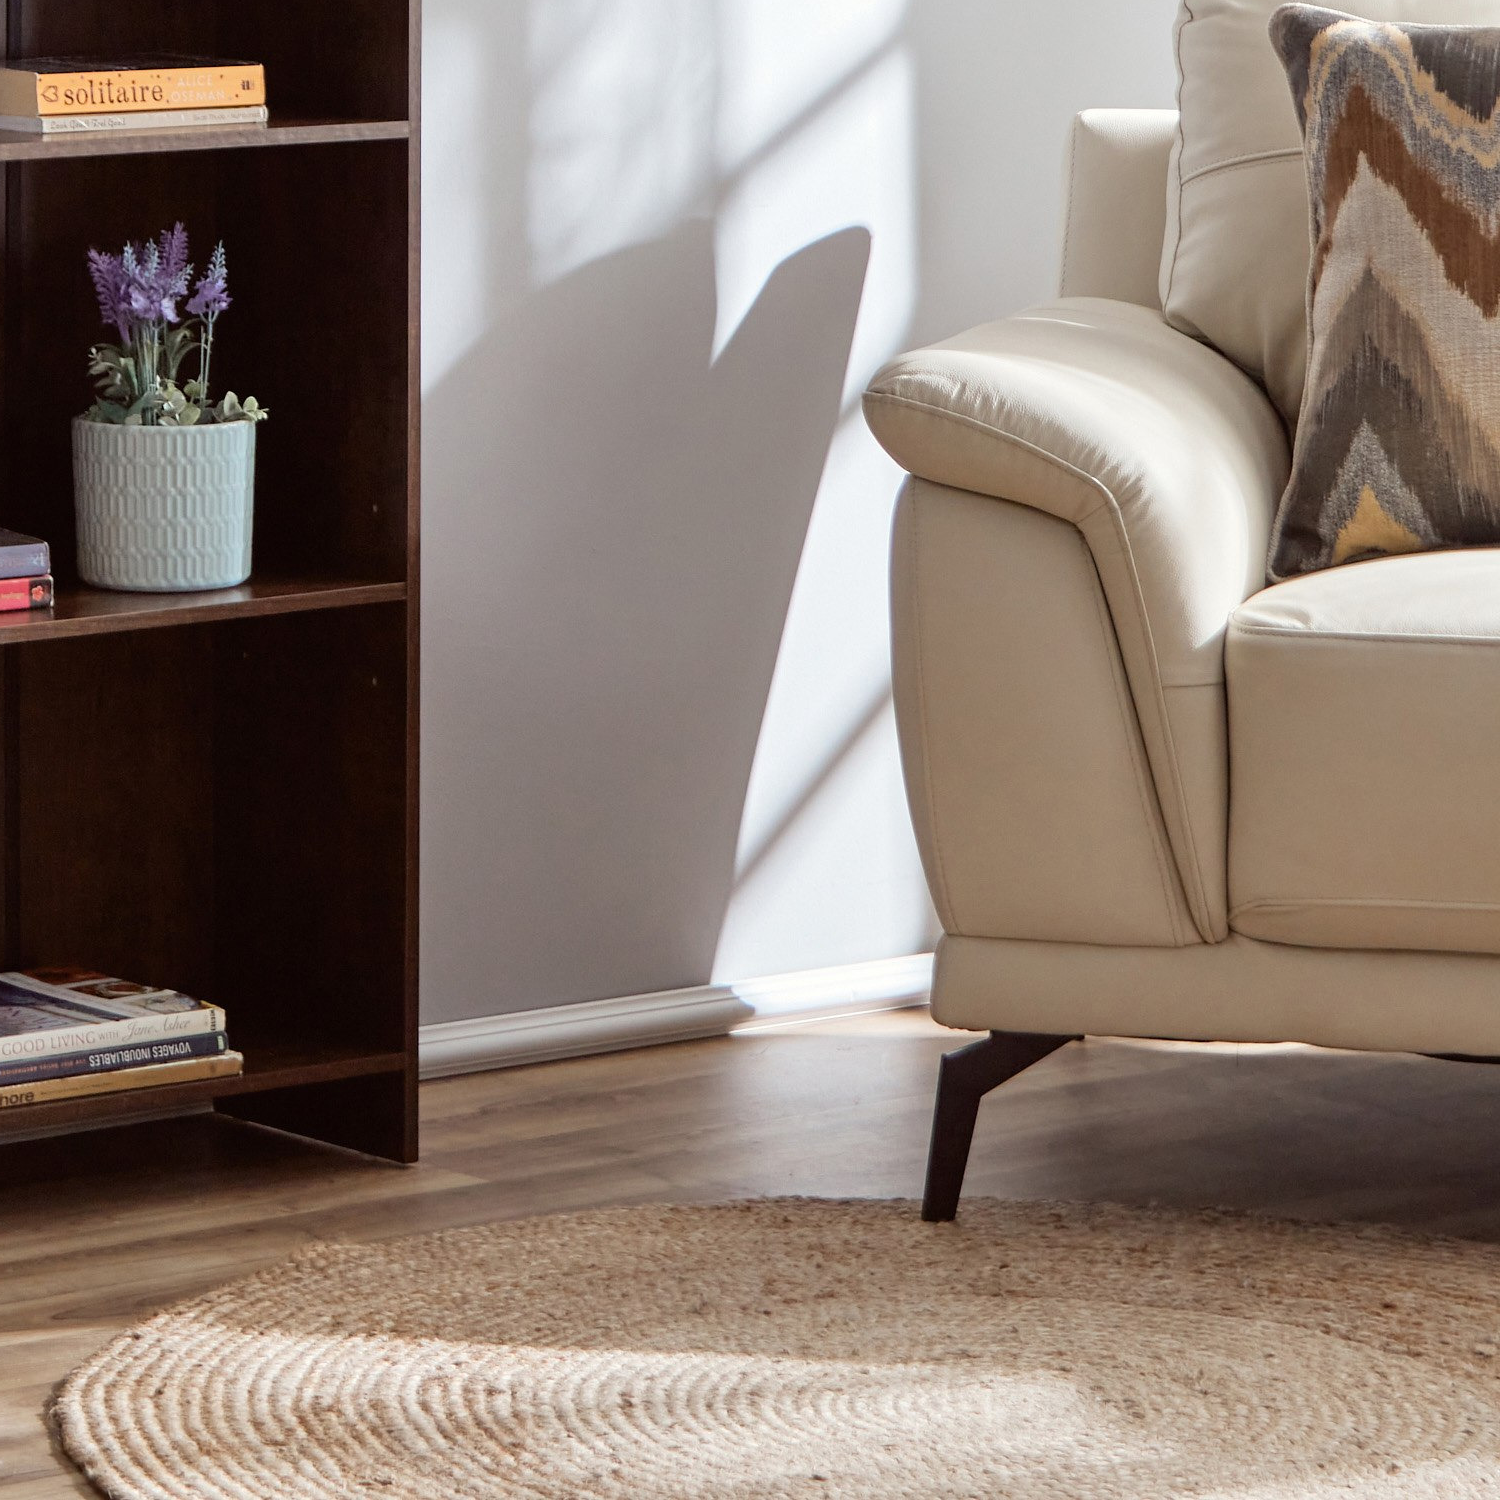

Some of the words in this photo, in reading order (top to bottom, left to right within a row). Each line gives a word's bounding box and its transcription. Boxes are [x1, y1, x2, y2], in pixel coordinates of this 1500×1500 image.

[176, 74, 214, 89] ALICE
[63, 78, 164, 107] solitaire
[170, 88, 227, 103] OSEMAN
[2, 1037, 45, 1056] GOOD
[50, 1031, 96, 1050] LIVING
[98, 1029, 119, 1041] WITH
[121, 1017, 153, 1041] Jane
[88, 1045, 151, 1068] INOUBLIABLES
[152, 1041, 191, 1059] VOYAGES
